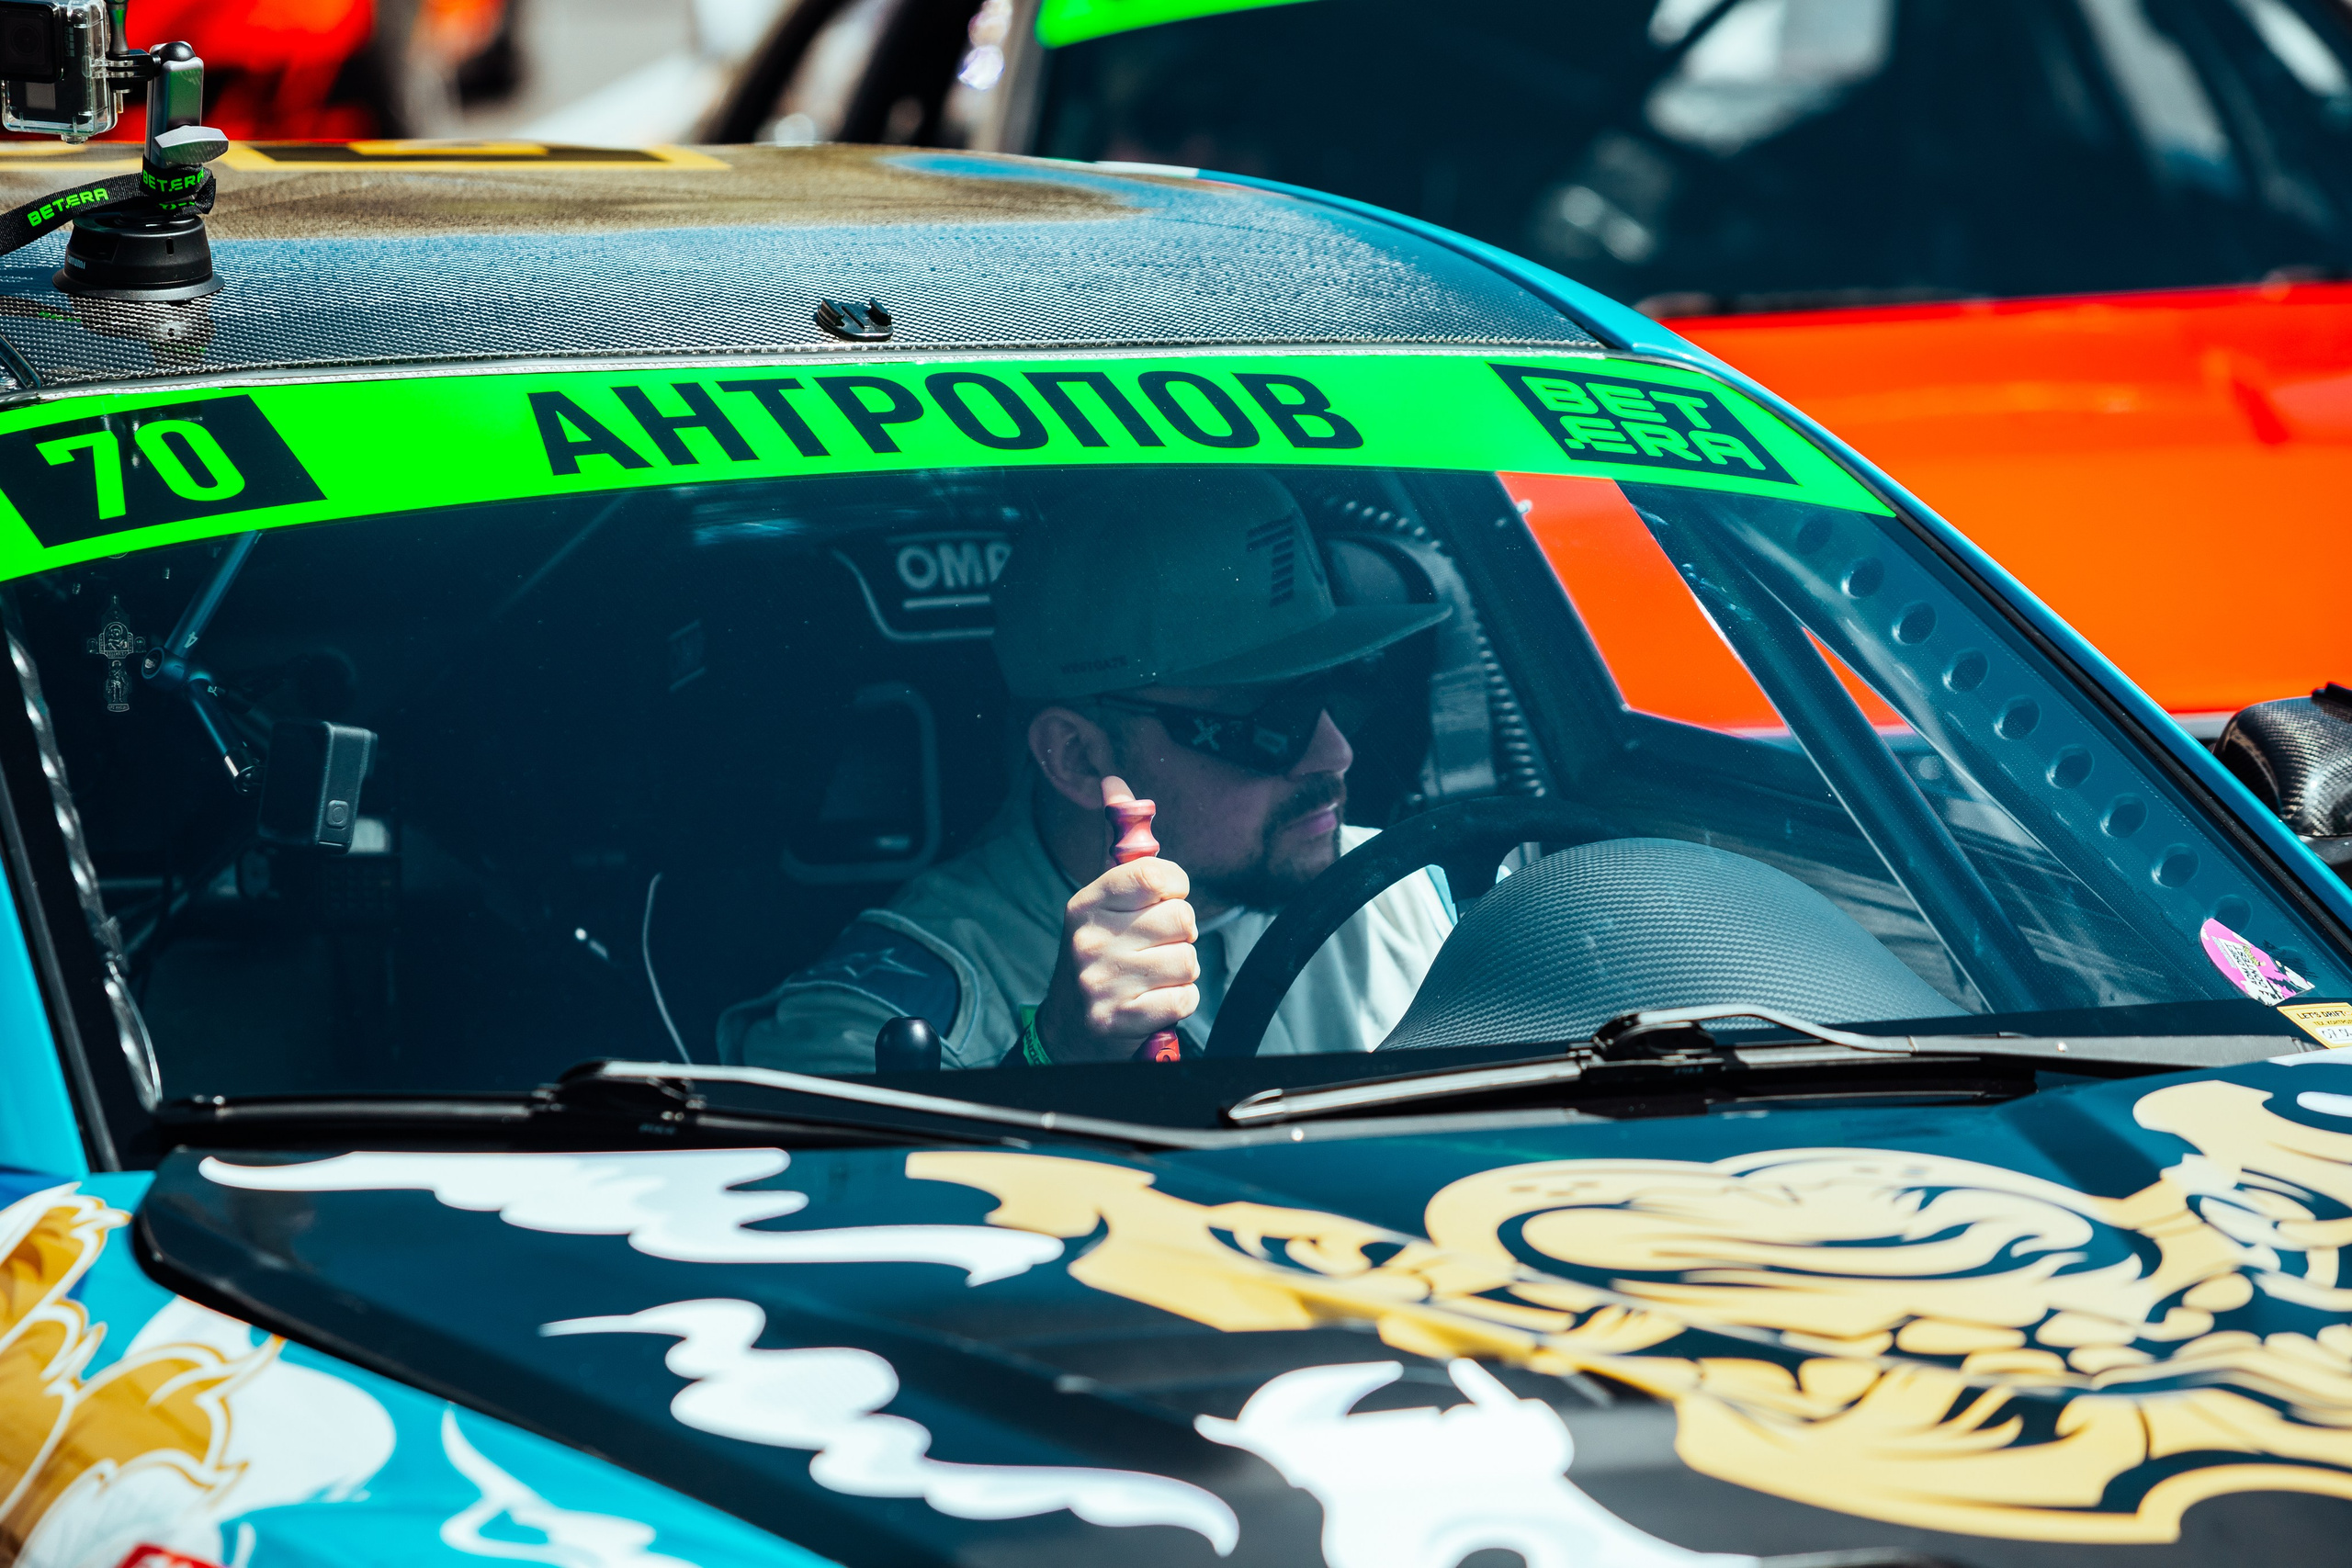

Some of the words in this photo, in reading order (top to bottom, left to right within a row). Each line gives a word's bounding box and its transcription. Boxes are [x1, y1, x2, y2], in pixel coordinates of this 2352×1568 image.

[27, 187, 109, 227] BETERA
[527, 371, 1363, 476] АНТРОПОВ
[1521, 376, 1712, 430] BET
[35, 419, 246, 520] 70
[1559, 415, 1766, 470] ERA
[896, 541, 1012, 590] OMP
[2321, 1010, 2345, 1018] DRIFT
